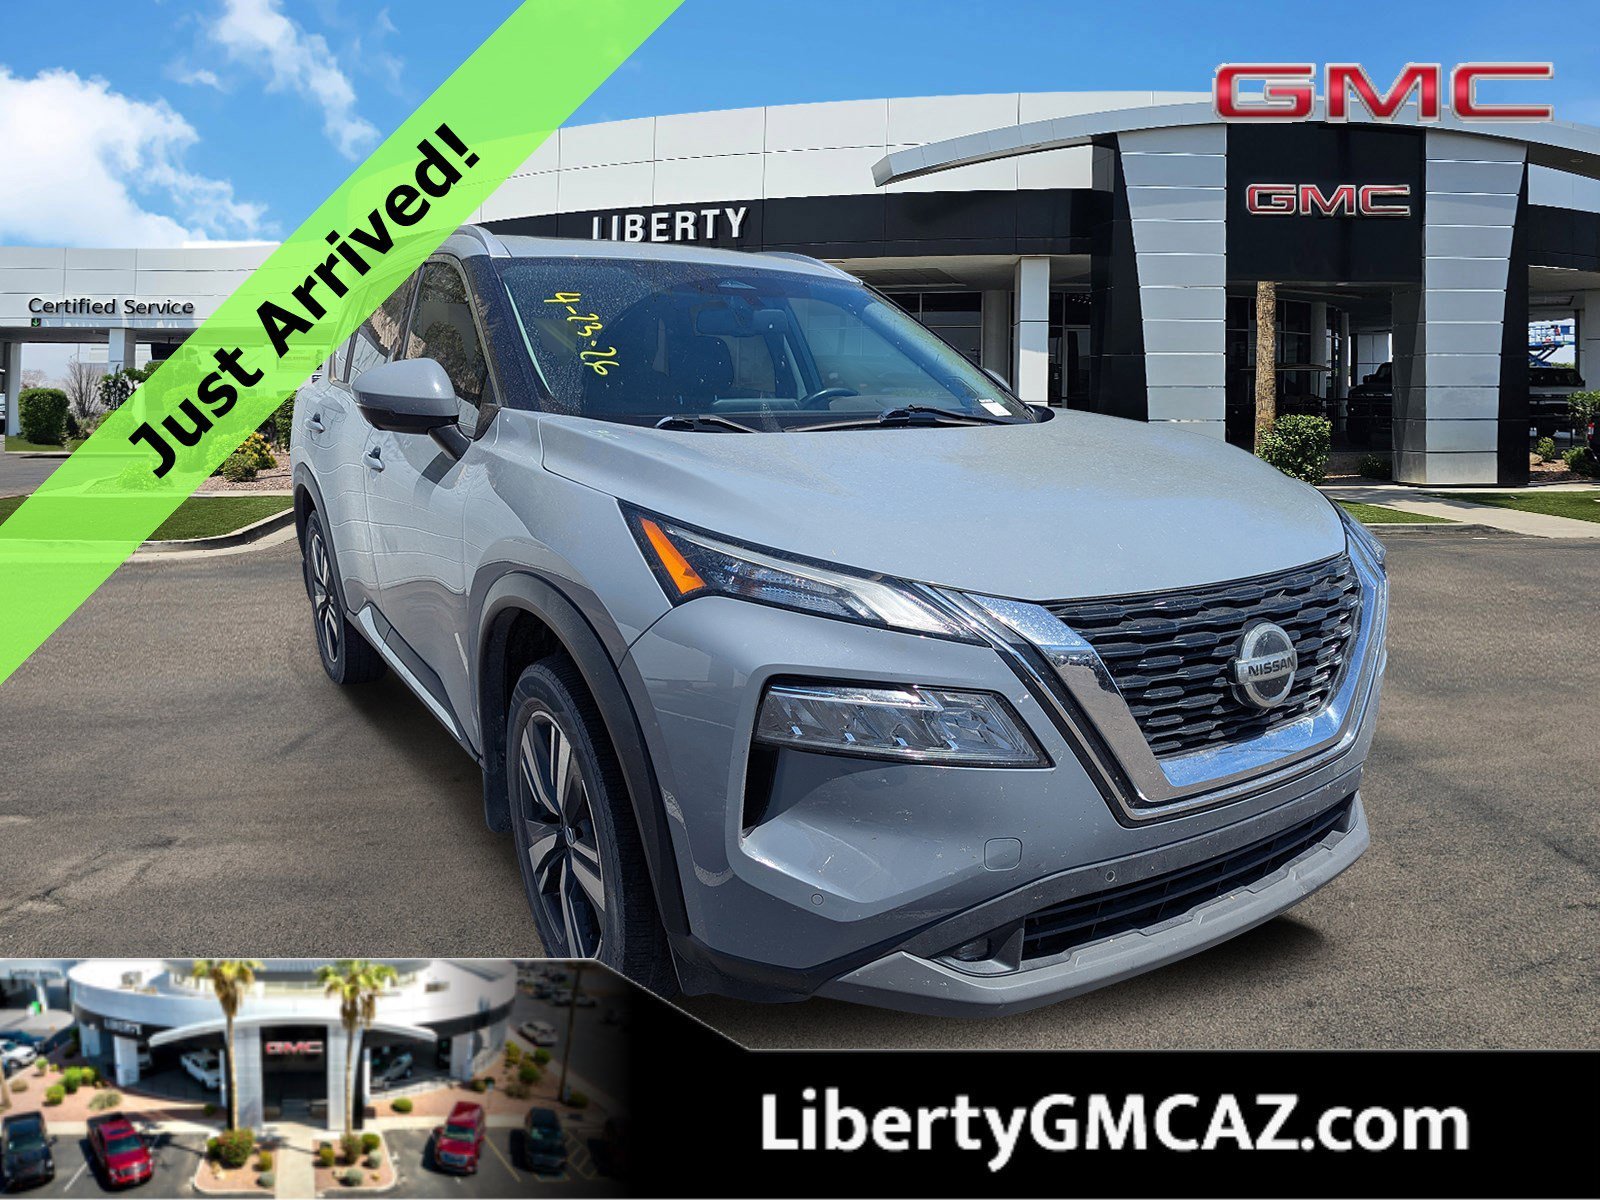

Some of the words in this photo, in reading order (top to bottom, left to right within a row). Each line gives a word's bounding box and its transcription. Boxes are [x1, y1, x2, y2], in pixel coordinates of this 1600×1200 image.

[1246, 184, 1411, 217] GMC
[592, 206, 748, 242] LIBERTY
[28, 297, 116, 315] Certified
[124, 299, 194, 315] Service
[1248, 656, 1294, 676] NISSAN
